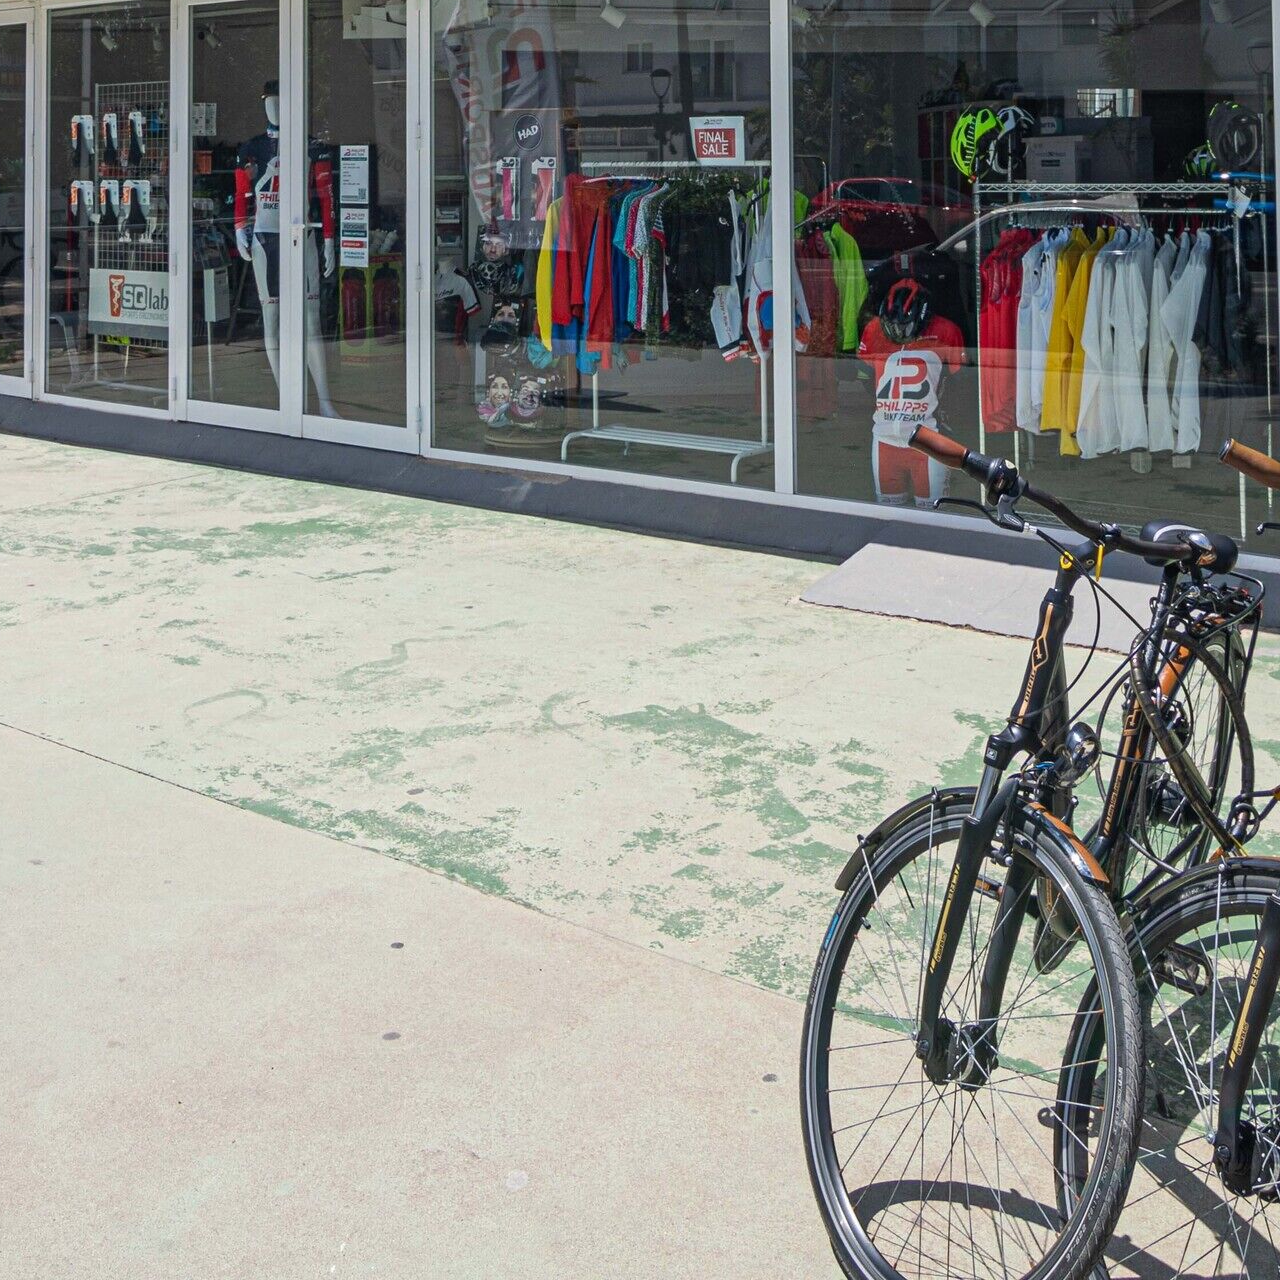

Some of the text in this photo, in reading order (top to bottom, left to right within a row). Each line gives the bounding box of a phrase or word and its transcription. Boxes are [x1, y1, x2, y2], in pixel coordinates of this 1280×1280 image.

[517, 124, 539, 140] HAD
[698, 131, 729, 143] FINAL
[702, 143, 729, 155] SALE
[263, 202, 280, 210] BIKE
[876, 400, 930, 413] PHILIPPS
[899, 412, 926, 422] TEAM
